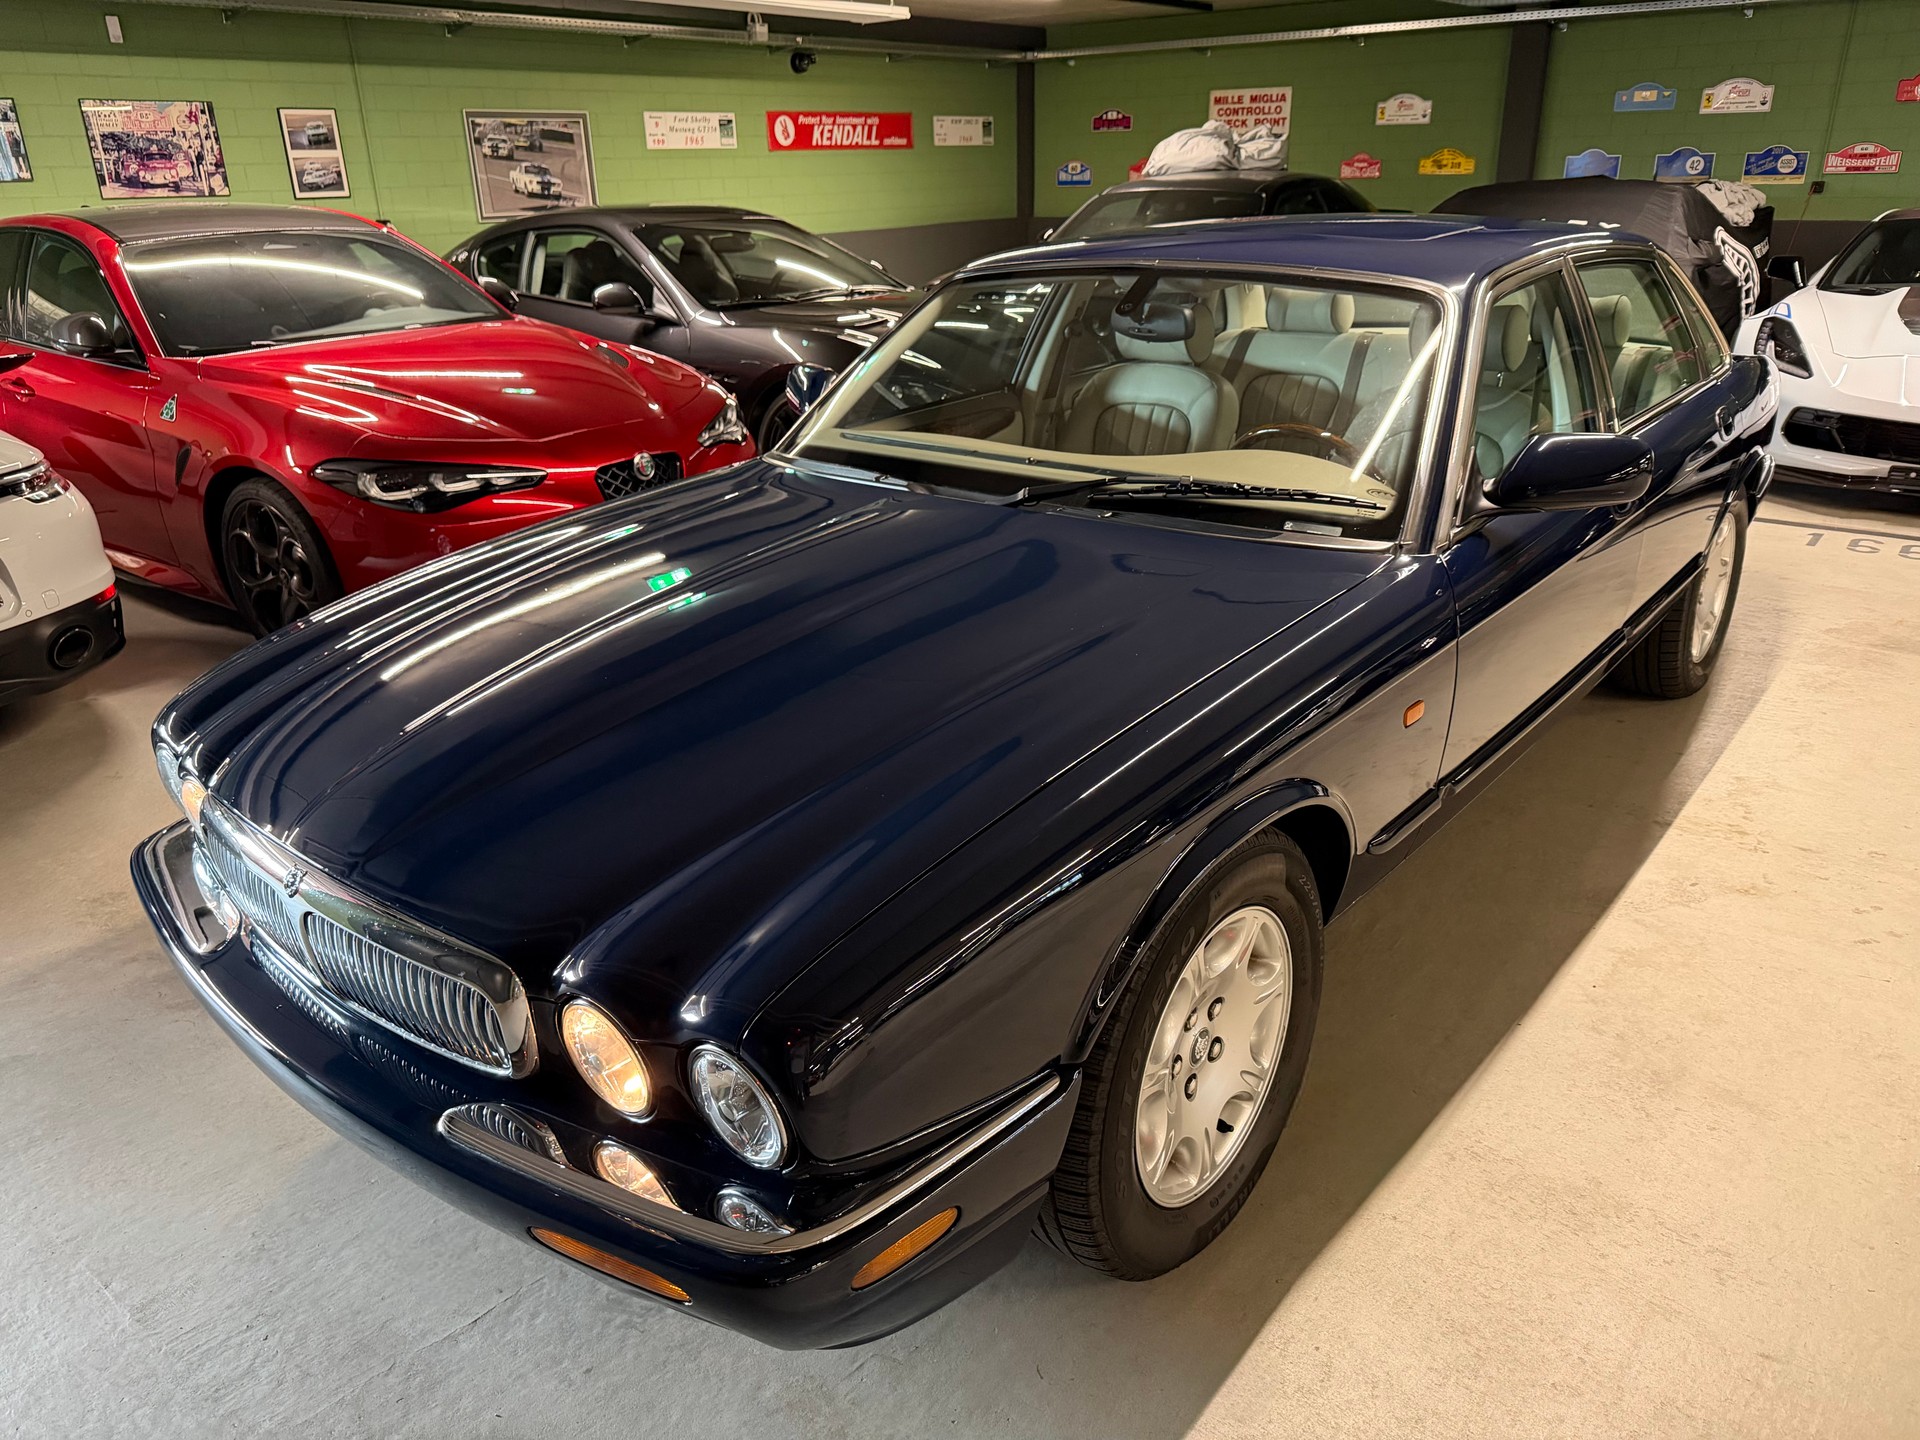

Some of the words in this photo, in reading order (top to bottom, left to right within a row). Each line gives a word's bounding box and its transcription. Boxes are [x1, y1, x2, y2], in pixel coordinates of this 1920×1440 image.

[1214, 95, 1244, 105] MILLE
[1250, 93, 1286, 104] MIGLIA
[1217, 105, 1282, 117] CONTROLLO
[1221, 118, 1248, 128] ECK
[685, 135, 705, 146] 1965
[812, 124, 880, 146] KENDALL
[1689, 159, 1701, 171] 42
[1828, 153, 1899, 167] WEISSENSTEIN
